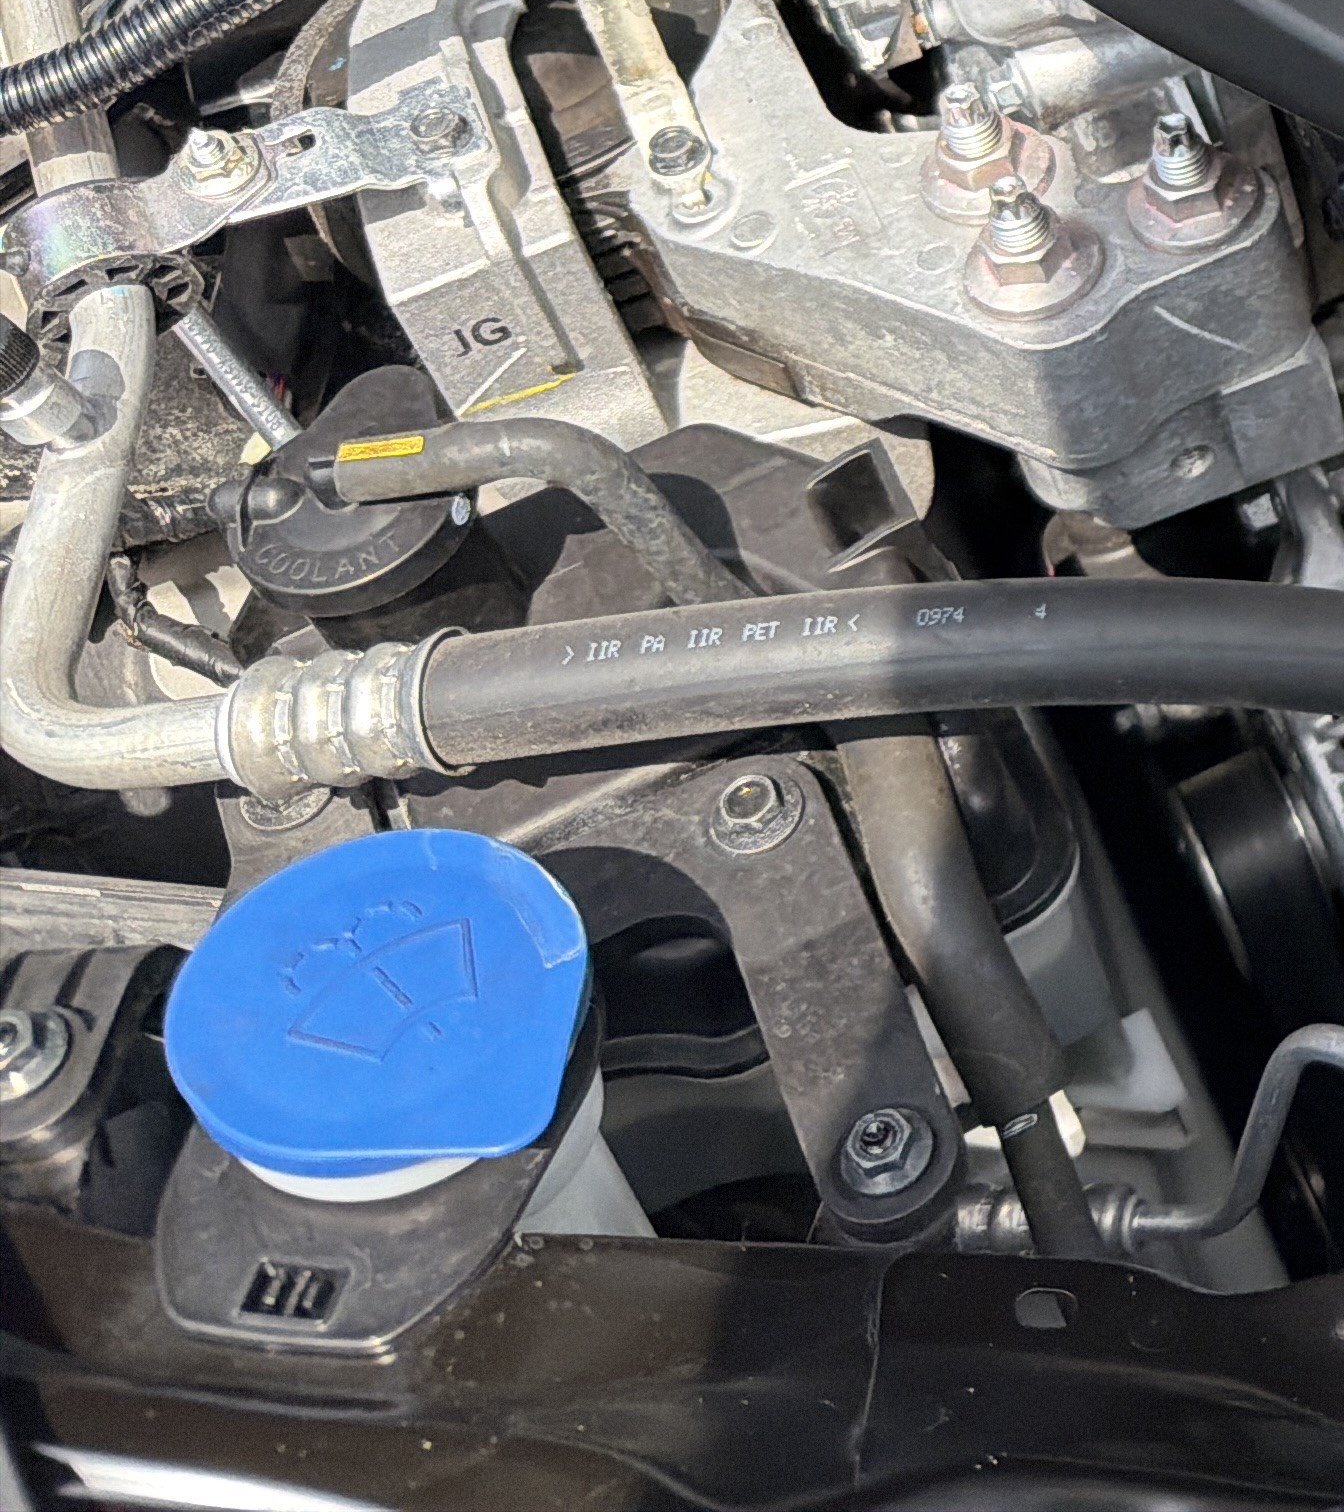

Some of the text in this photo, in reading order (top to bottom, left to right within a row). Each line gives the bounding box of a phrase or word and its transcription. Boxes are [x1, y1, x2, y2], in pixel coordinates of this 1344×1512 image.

[453, 317, 513, 358] JG
[254, 530, 400, 582] COOLANT
[586, 639, 622, 662] IIR
[639, 634, 666, 655] PA
[686, 627, 723, 650] IIR
[741, 621, 781, 641] PET
[800, 616, 838, 637] IIR
[916, 605, 966, 627] 0974
